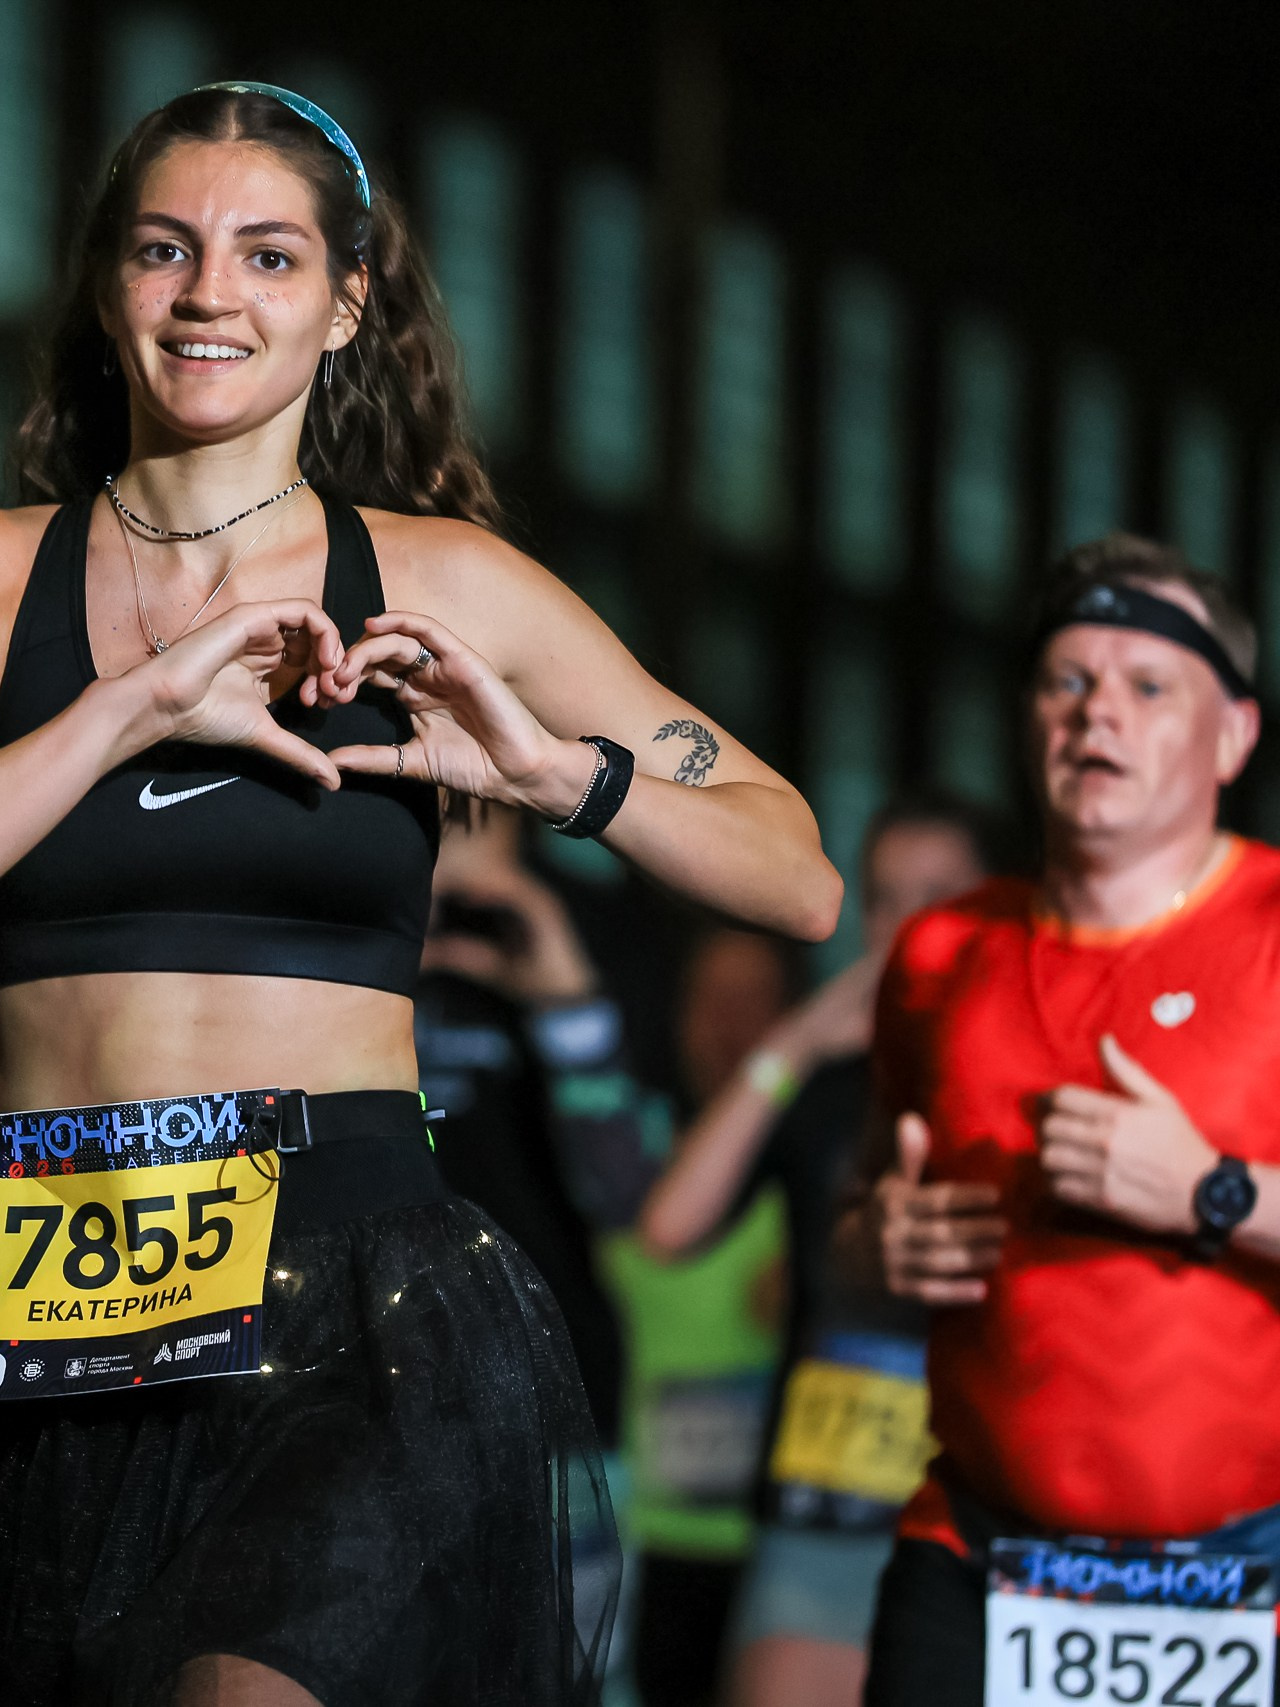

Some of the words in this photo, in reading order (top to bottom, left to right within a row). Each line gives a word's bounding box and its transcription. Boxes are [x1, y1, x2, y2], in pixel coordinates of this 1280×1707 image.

[107, 1149, 204, 1172] ЗАБЕГ
[4, 1186, 238, 1291] 7855
[27, 1283, 193, 1323] ЕКАТЕРИНА
[174, 1346, 201, 1361] СПОРТ
[176, 1328, 231, 1350] МОСКОВСКИЙ
[1007, 1626, 1261, 1707] 18522
